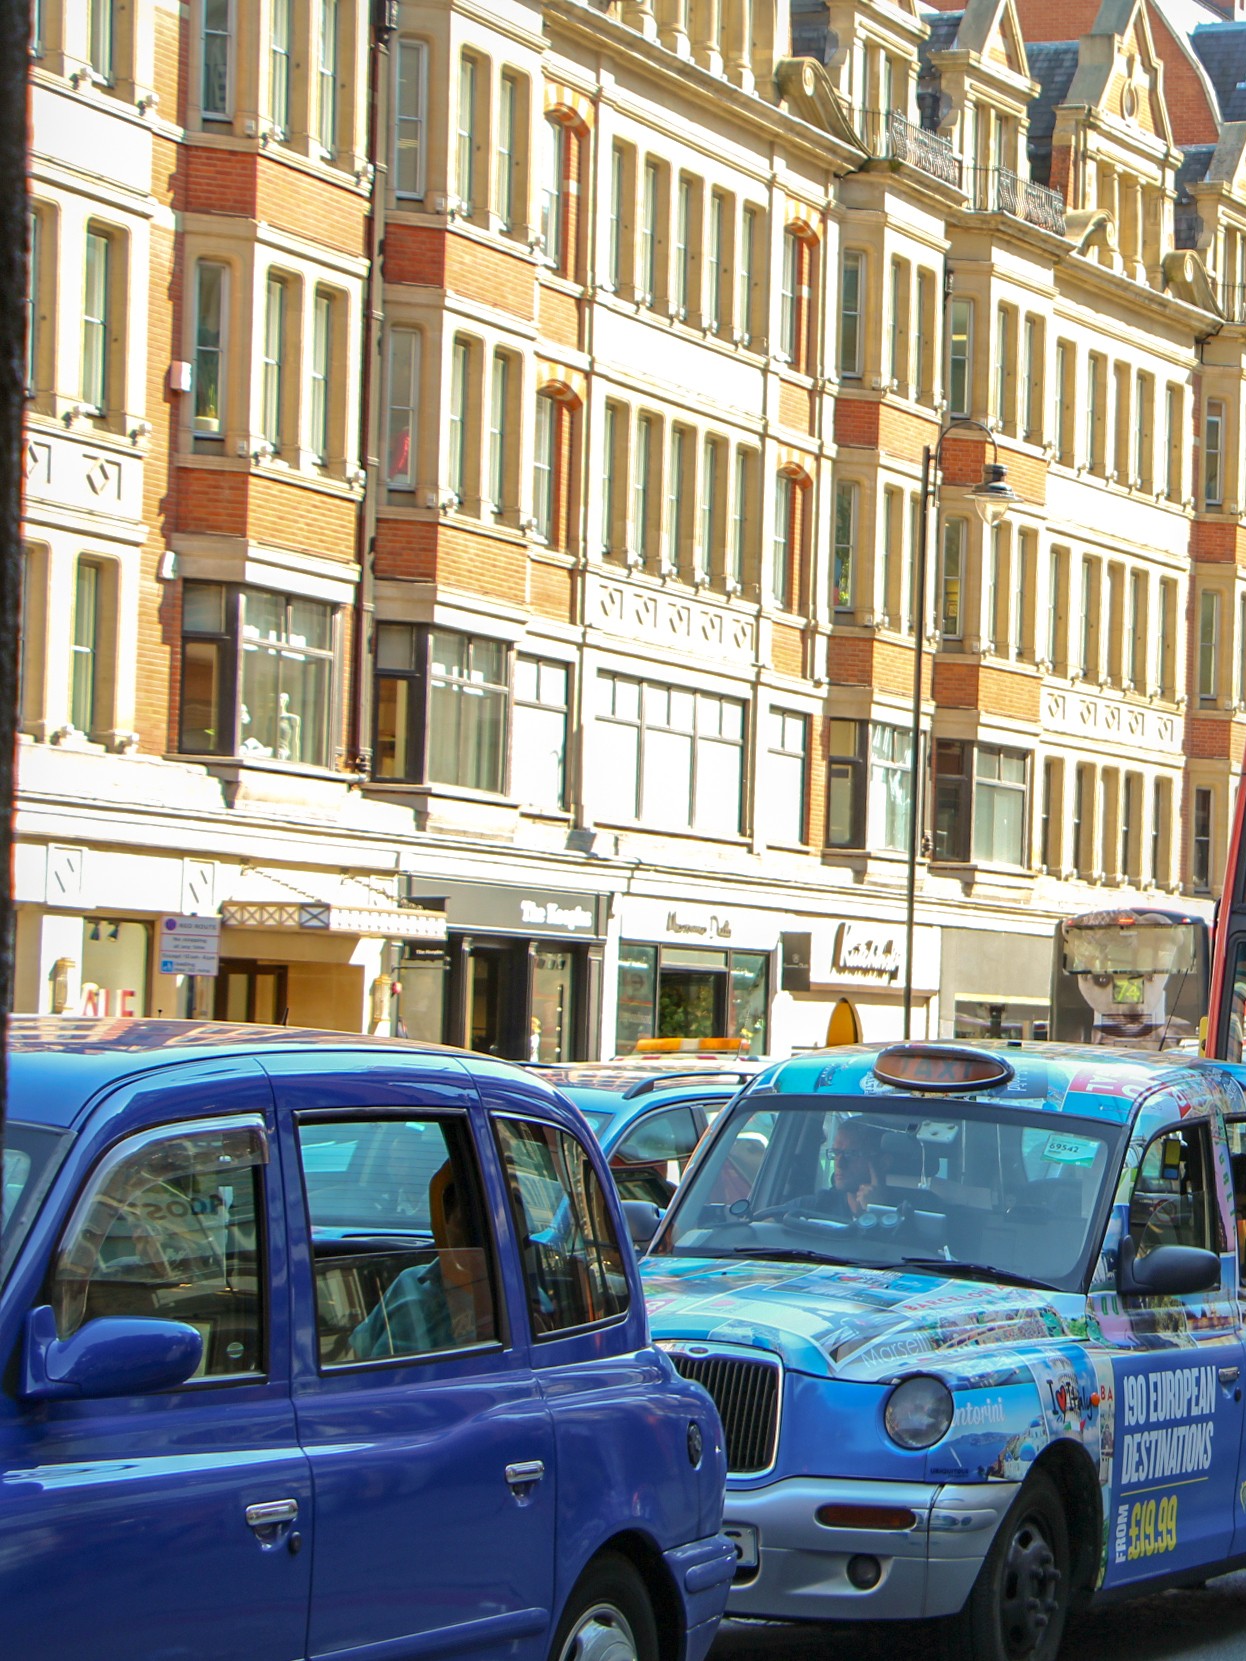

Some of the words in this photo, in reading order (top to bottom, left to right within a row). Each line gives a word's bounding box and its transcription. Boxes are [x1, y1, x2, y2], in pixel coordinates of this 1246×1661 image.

[520, 900, 546, 924] The
[1116, 981, 1140, 1002] 74
[900, 1057, 973, 1080] TAXI
[1123, 1374, 1147, 1427] 190
[1148, 1365, 1217, 1423] EUROPEAN
[1121, 1420, 1214, 1485] DESTINATIONS
[1115, 1504, 1130, 1564] FROM
[1127, 1495, 1178, 1561] £19.99
